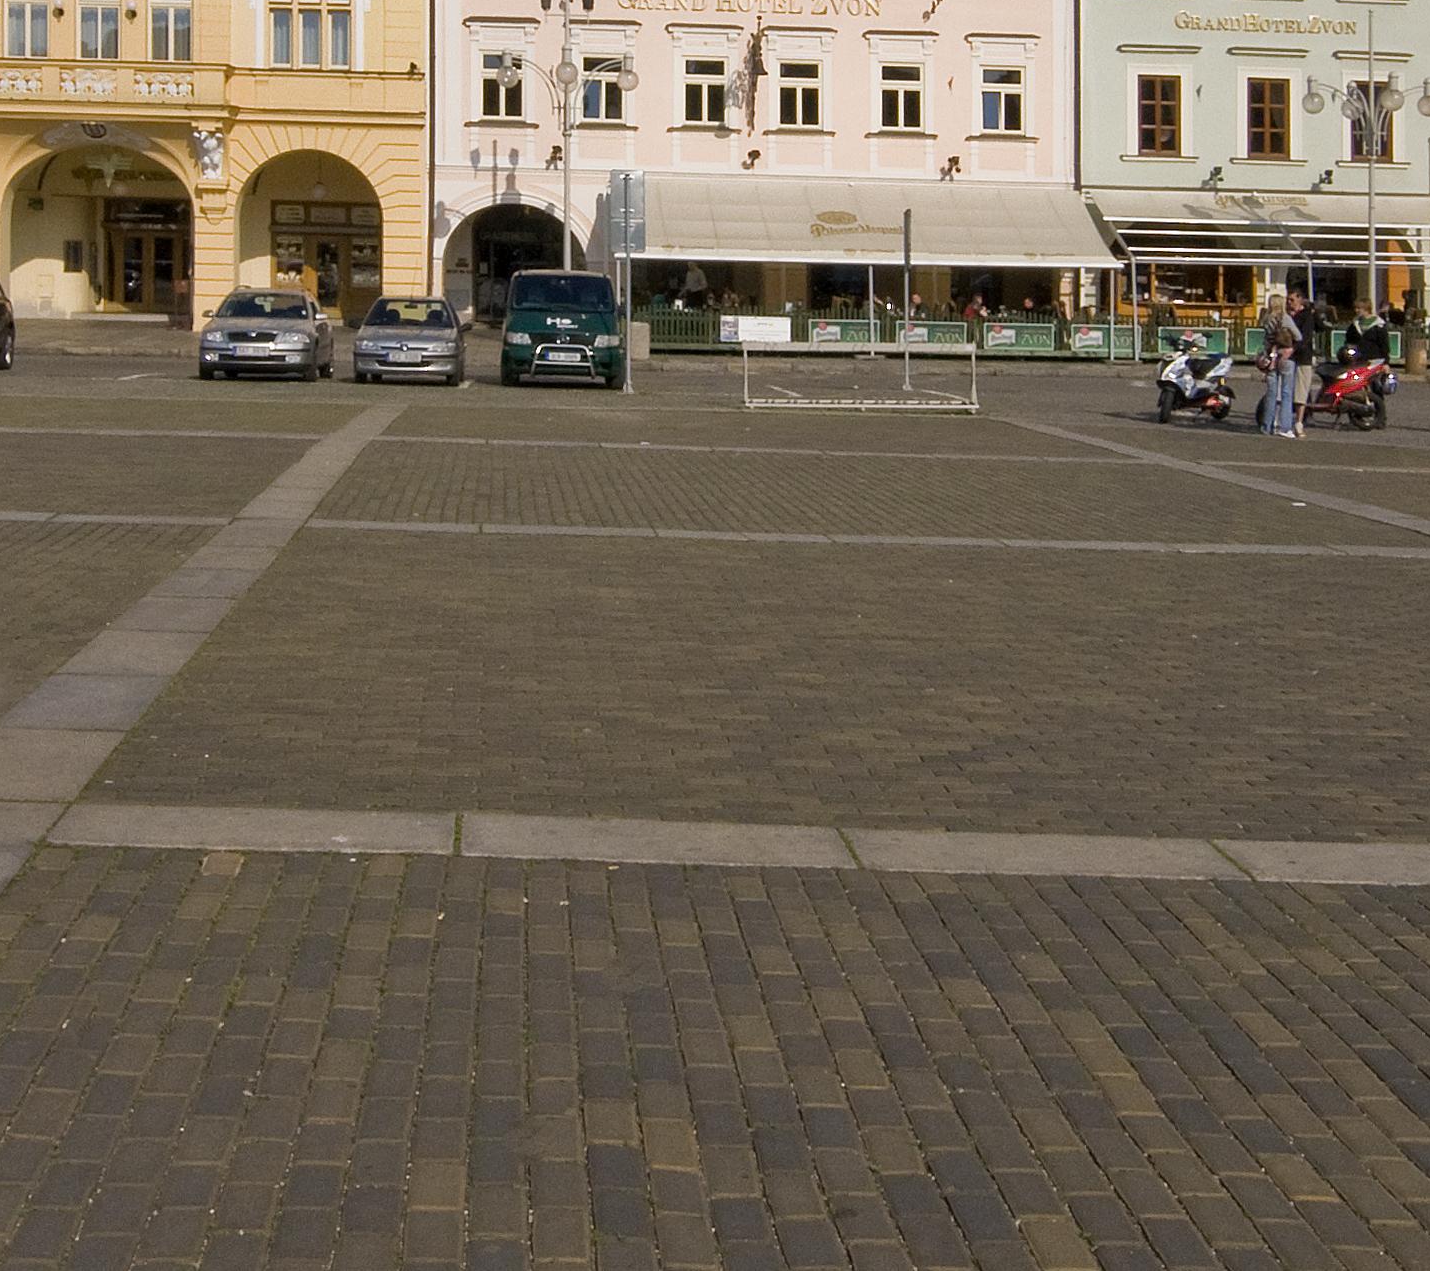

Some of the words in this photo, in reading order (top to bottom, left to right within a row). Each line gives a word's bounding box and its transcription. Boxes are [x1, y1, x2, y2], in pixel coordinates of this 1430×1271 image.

[1174, 9, 1242, 31] GRAND
[1242, 12, 1307, 34] HOTEL
[1307, 14, 1357, 35] ZVON
